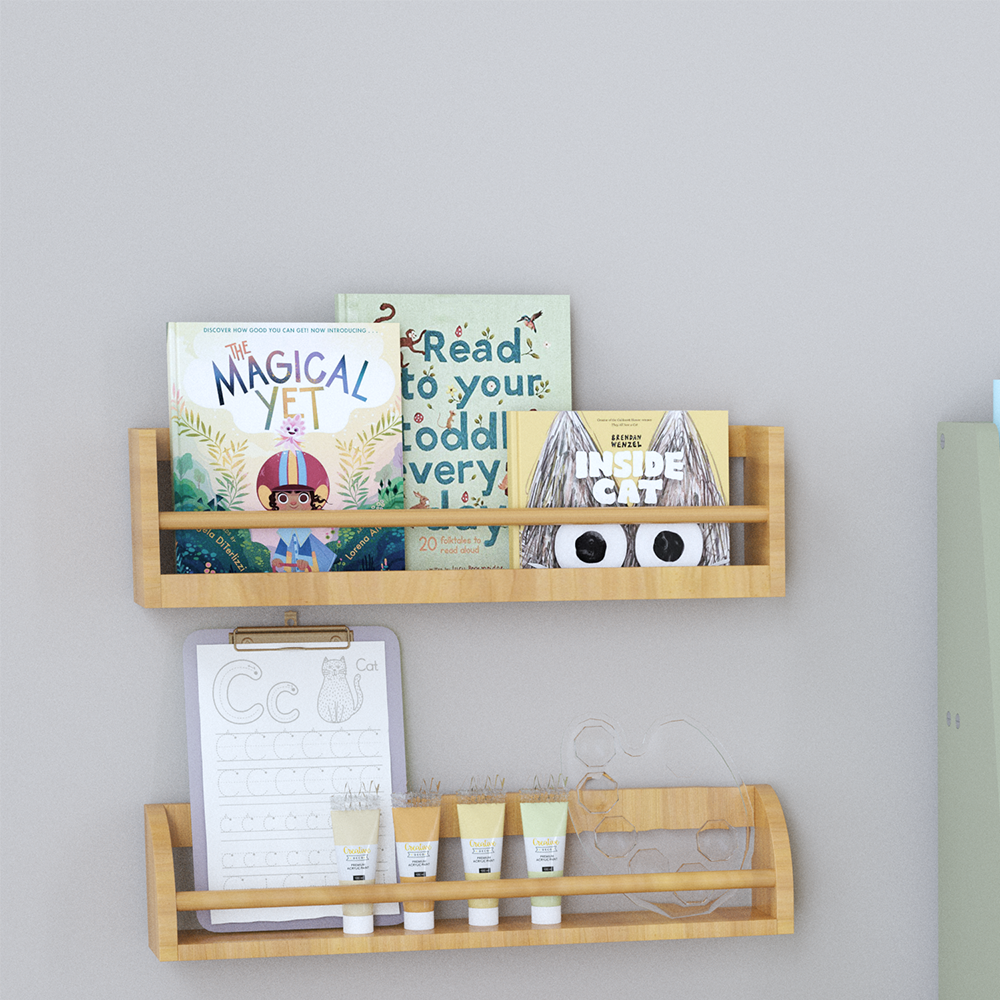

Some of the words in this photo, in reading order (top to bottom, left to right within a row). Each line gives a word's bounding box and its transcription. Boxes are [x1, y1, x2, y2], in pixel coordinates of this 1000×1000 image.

[225, 340, 252, 361] THE
[424, 327, 521, 363] Read
[212, 350, 369, 406] MAGICAL
[401, 367, 438, 400] to
[454, 374, 542, 410] your
[255, 386, 325, 430] YET
[575, 450, 684, 480] INSIDE
[403, 460, 500, 496] very
[593, 478, 663, 505] CAT
[215, 536, 247, 572] DiTerlizzi
[344, 536, 370, 560] Lorena
[419, 536, 437, 552] 20
[440, 536, 472, 544] folktales
[460, 546, 480, 554] aloud
[356, 658, 378, 672] Cat
[343, 846, 371, 855] Creative
[405, 843, 432, 851] Creative
[469, 839, 496, 847] Creative
[532, 838, 559, 846] Creative
